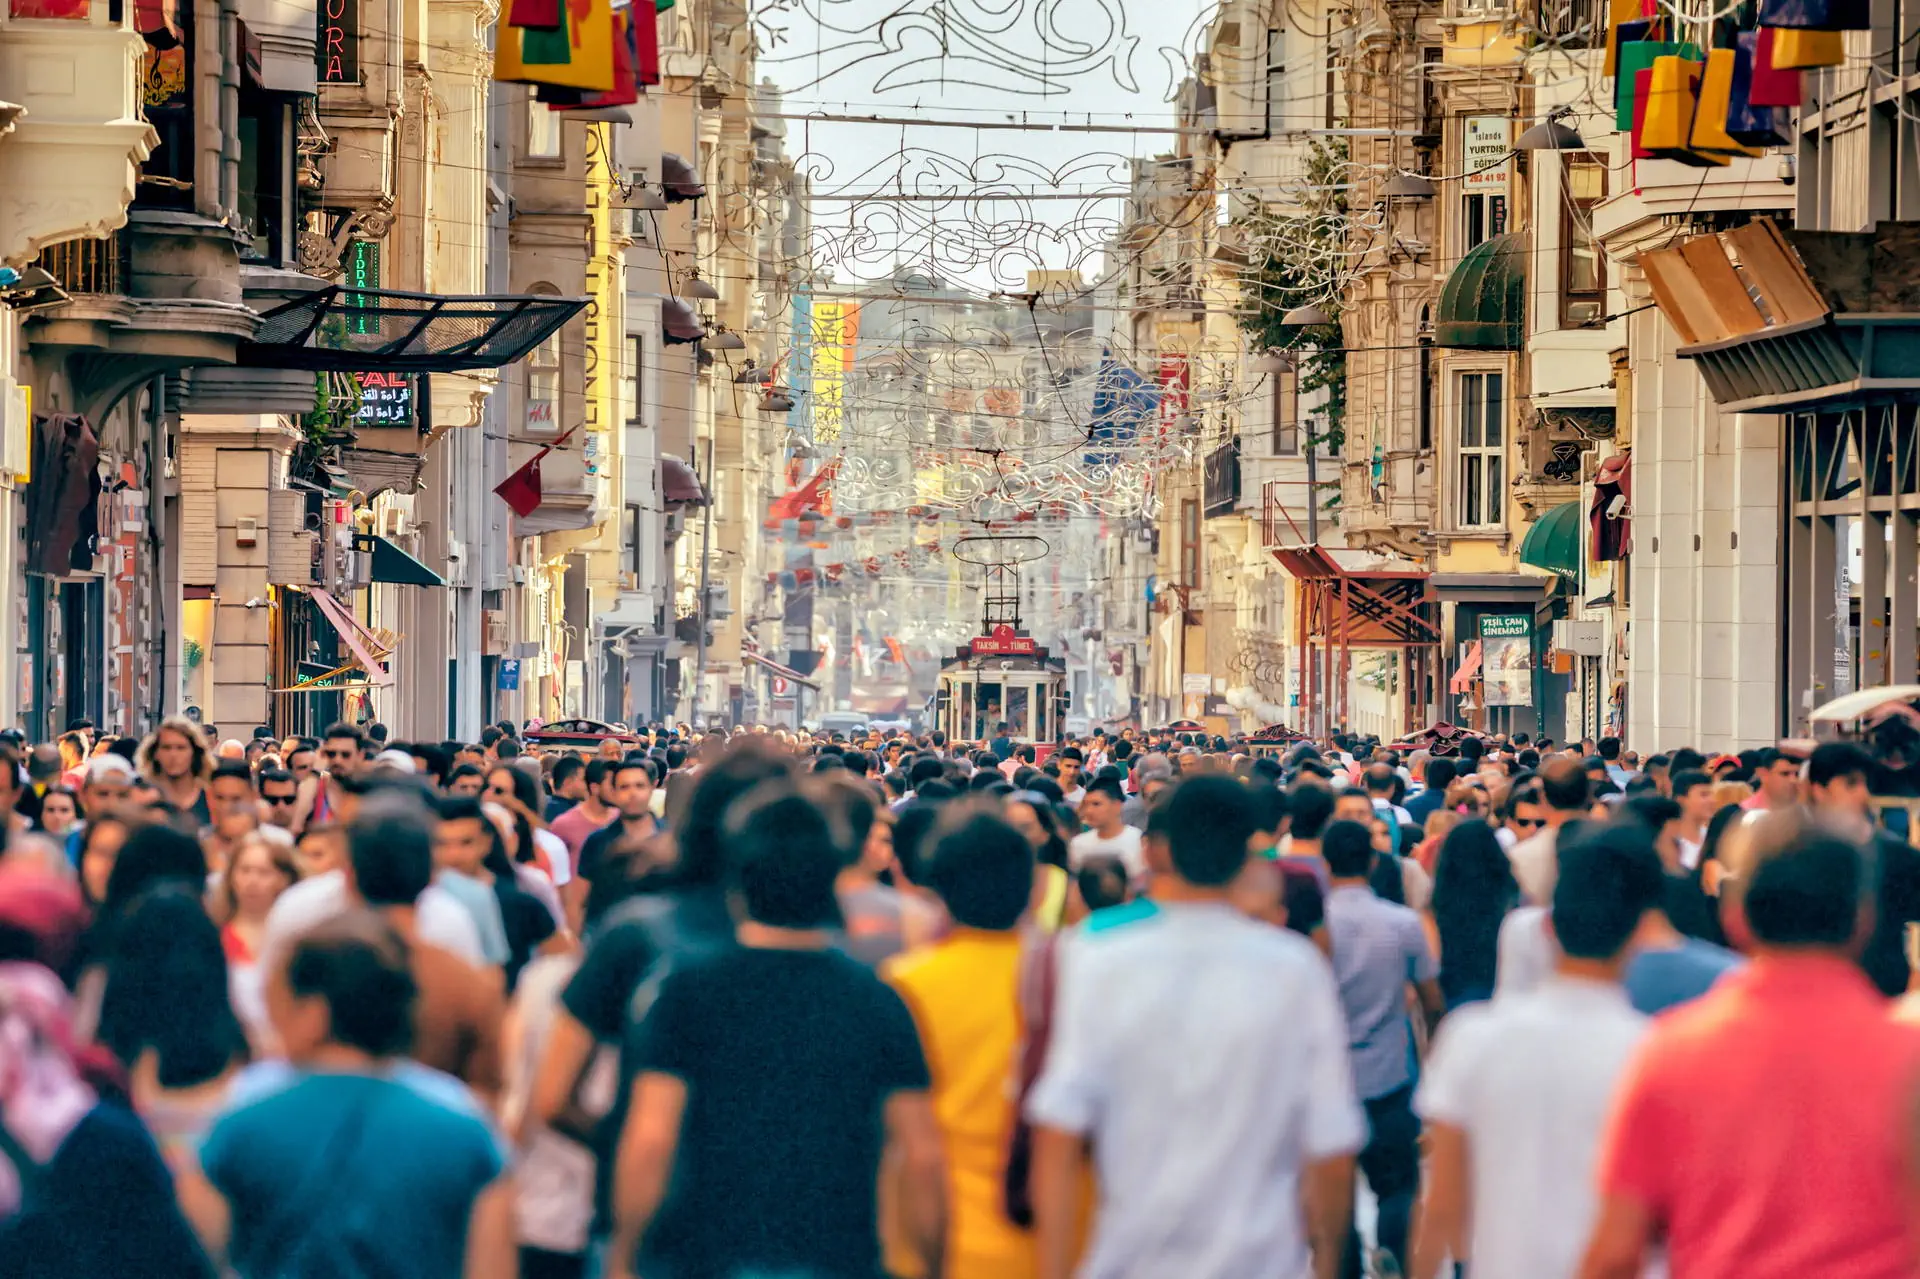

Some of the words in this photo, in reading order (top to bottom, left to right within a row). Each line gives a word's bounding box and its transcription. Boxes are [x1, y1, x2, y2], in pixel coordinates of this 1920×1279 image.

[1476, 132, 1501, 141] islands
[1484, 617, 1503, 627] YEŞİL
[1505, 618, 1522, 627] ÇAM
[1000, 626, 1007, 636] 2
